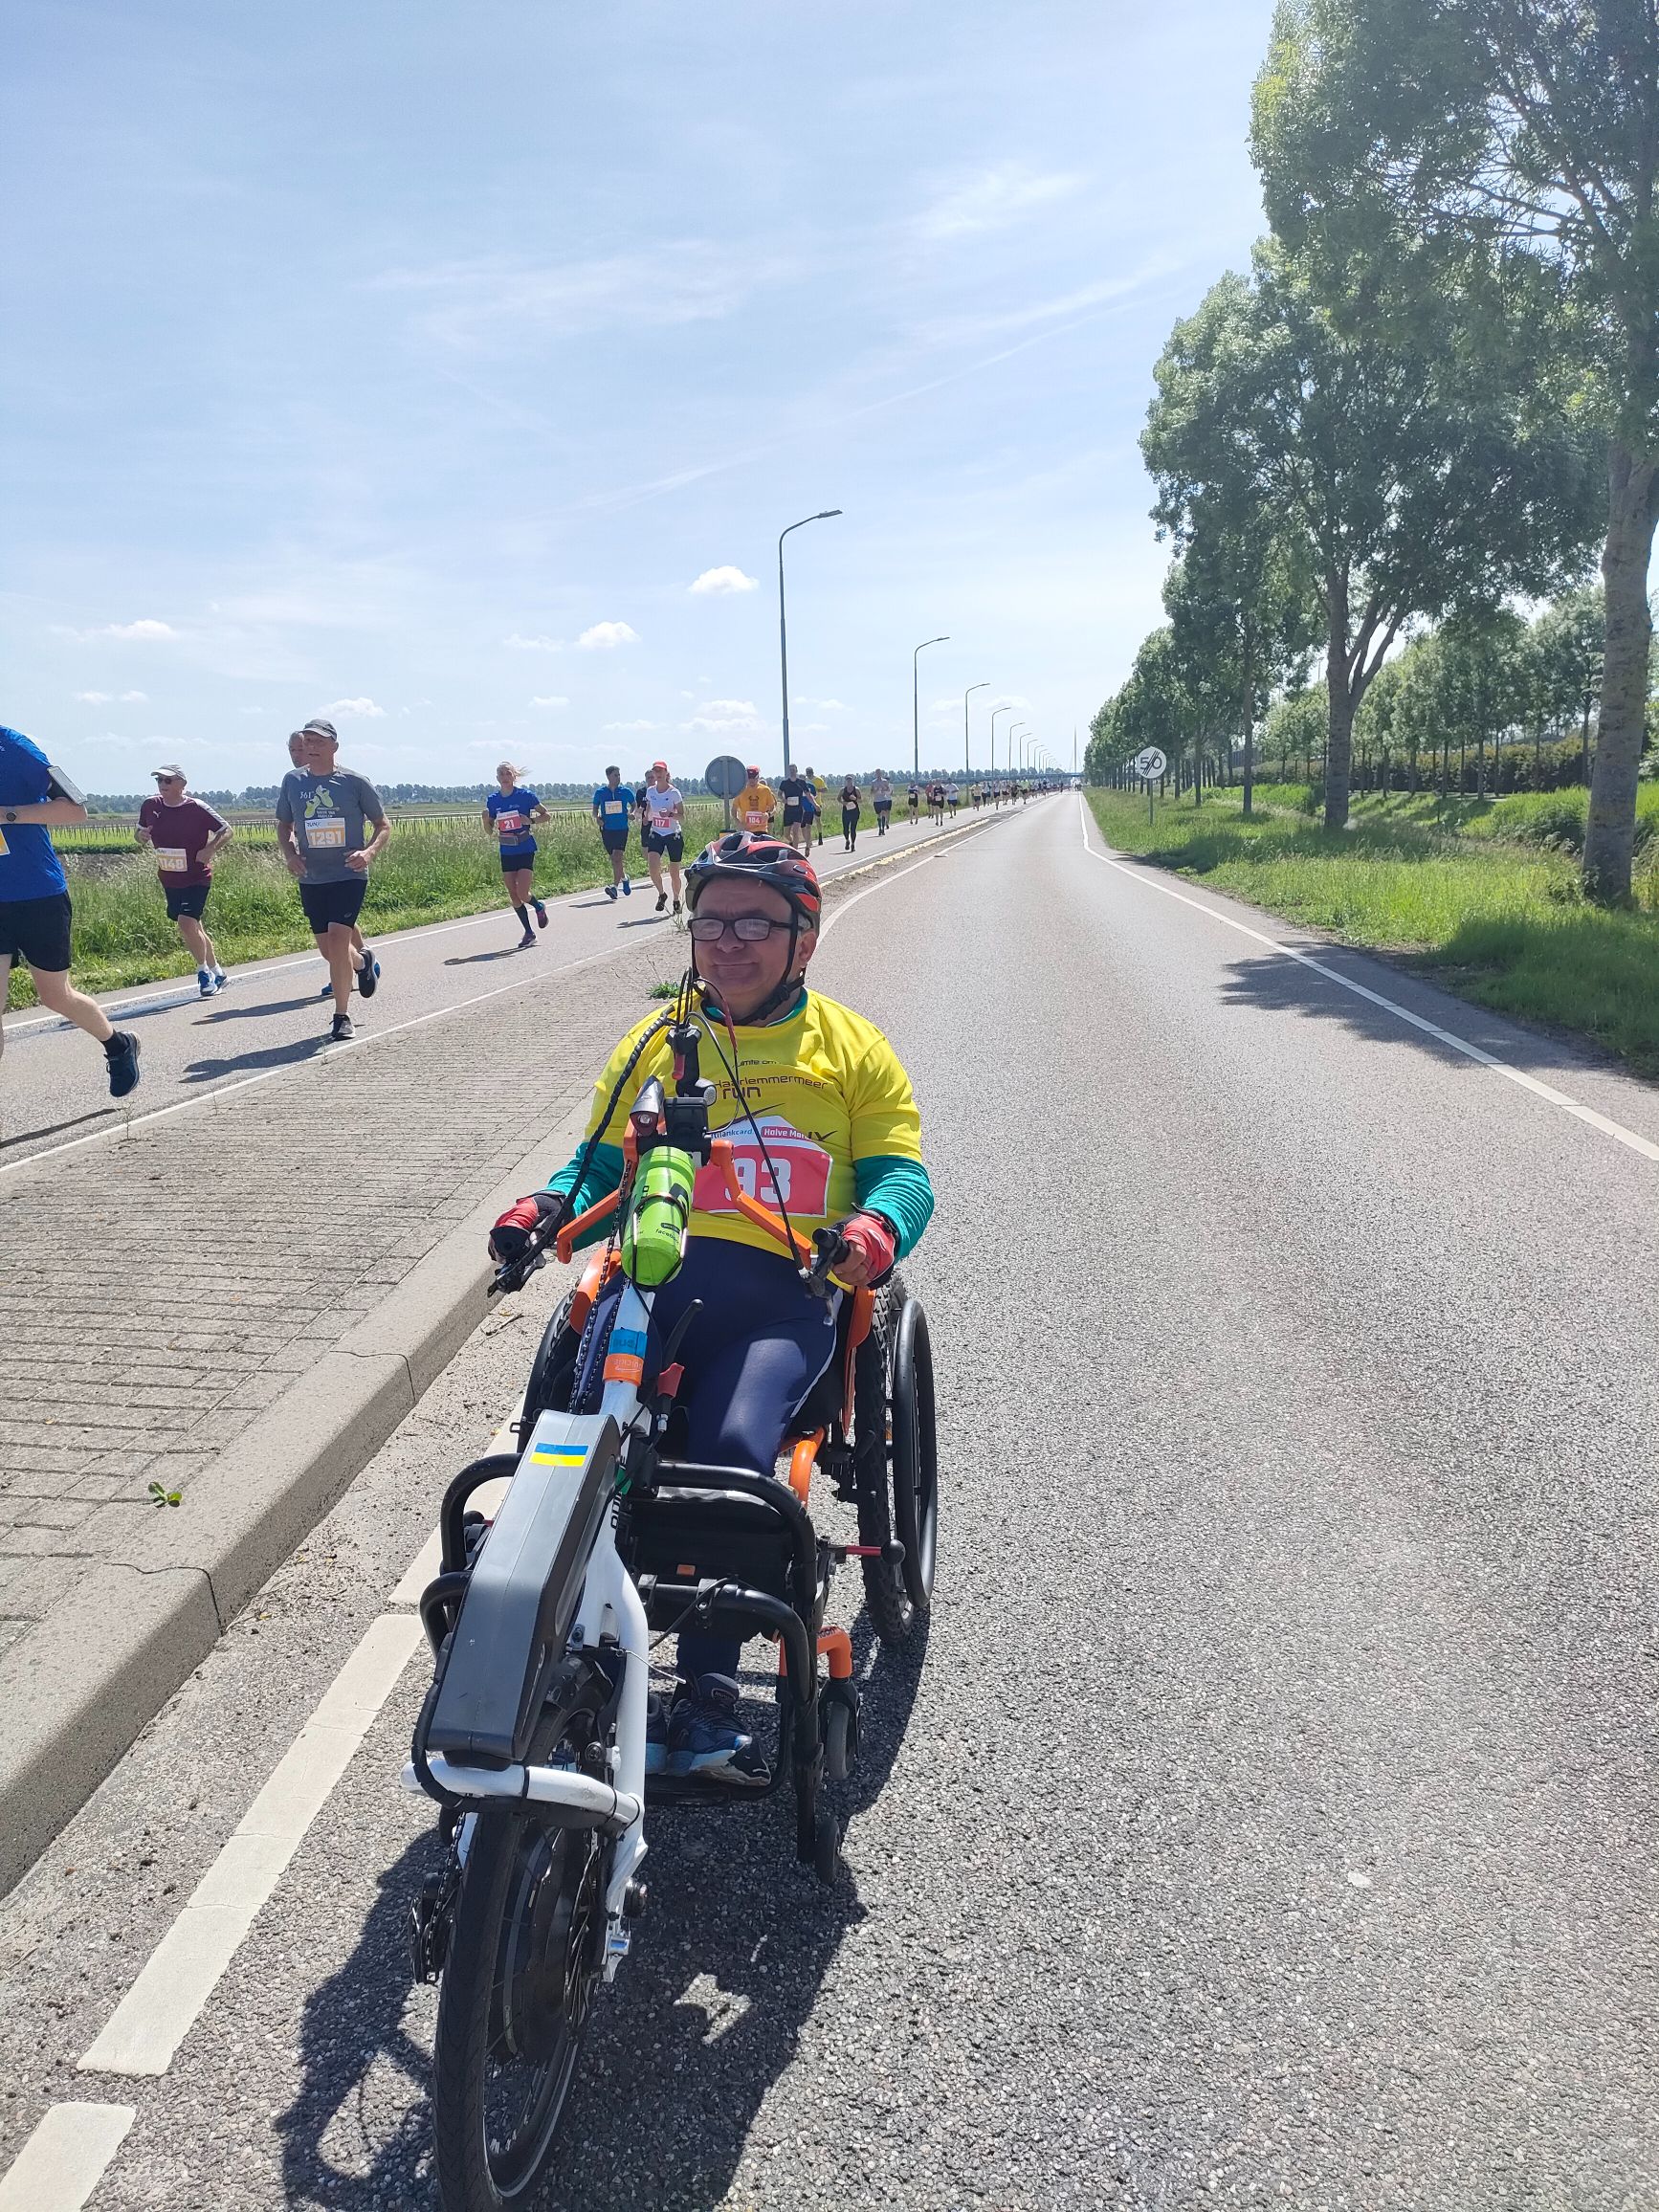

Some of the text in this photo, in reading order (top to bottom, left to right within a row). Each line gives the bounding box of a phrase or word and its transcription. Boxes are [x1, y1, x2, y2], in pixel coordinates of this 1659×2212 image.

[1139, 756, 1162, 769] 50
[503, 818, 515, 829] 21
[654, 818, 666, 827] 117
[309, 830, 343, 846] 1291
[722, 1086, 762, 1100] run
[763, 1128, 787, 1137] Halve
[724, 1158, 792, 1204] 93
